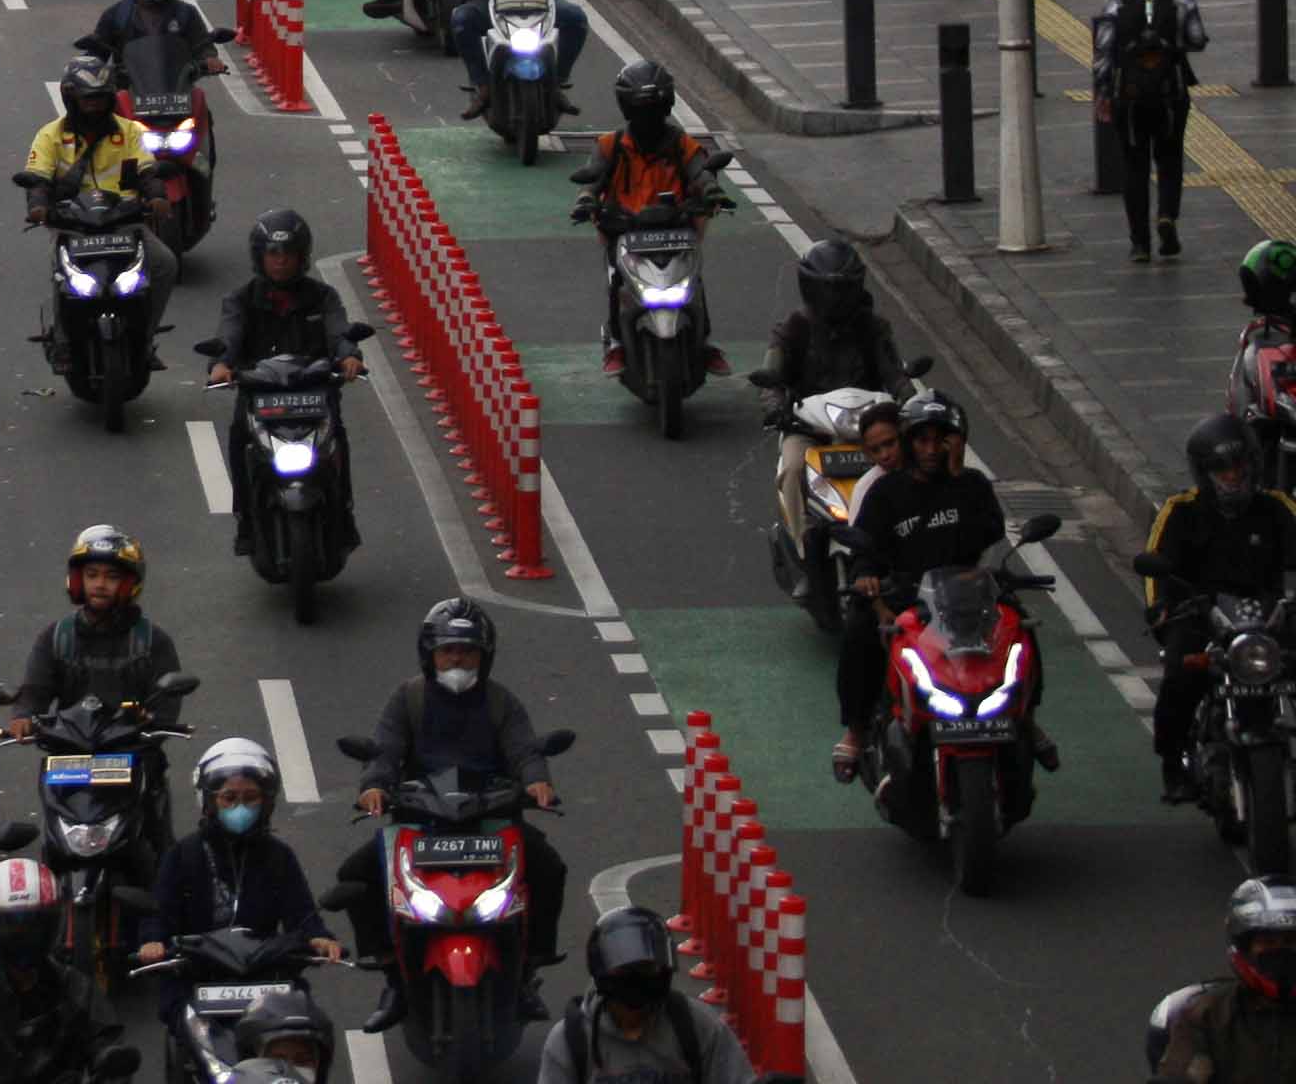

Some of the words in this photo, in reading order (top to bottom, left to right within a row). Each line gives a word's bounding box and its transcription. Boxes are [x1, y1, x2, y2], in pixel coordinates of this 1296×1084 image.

[416, 840, 426, 852] B
[432, 839, 465, 852] 4267
[474, 838, 499, 852] TNV
